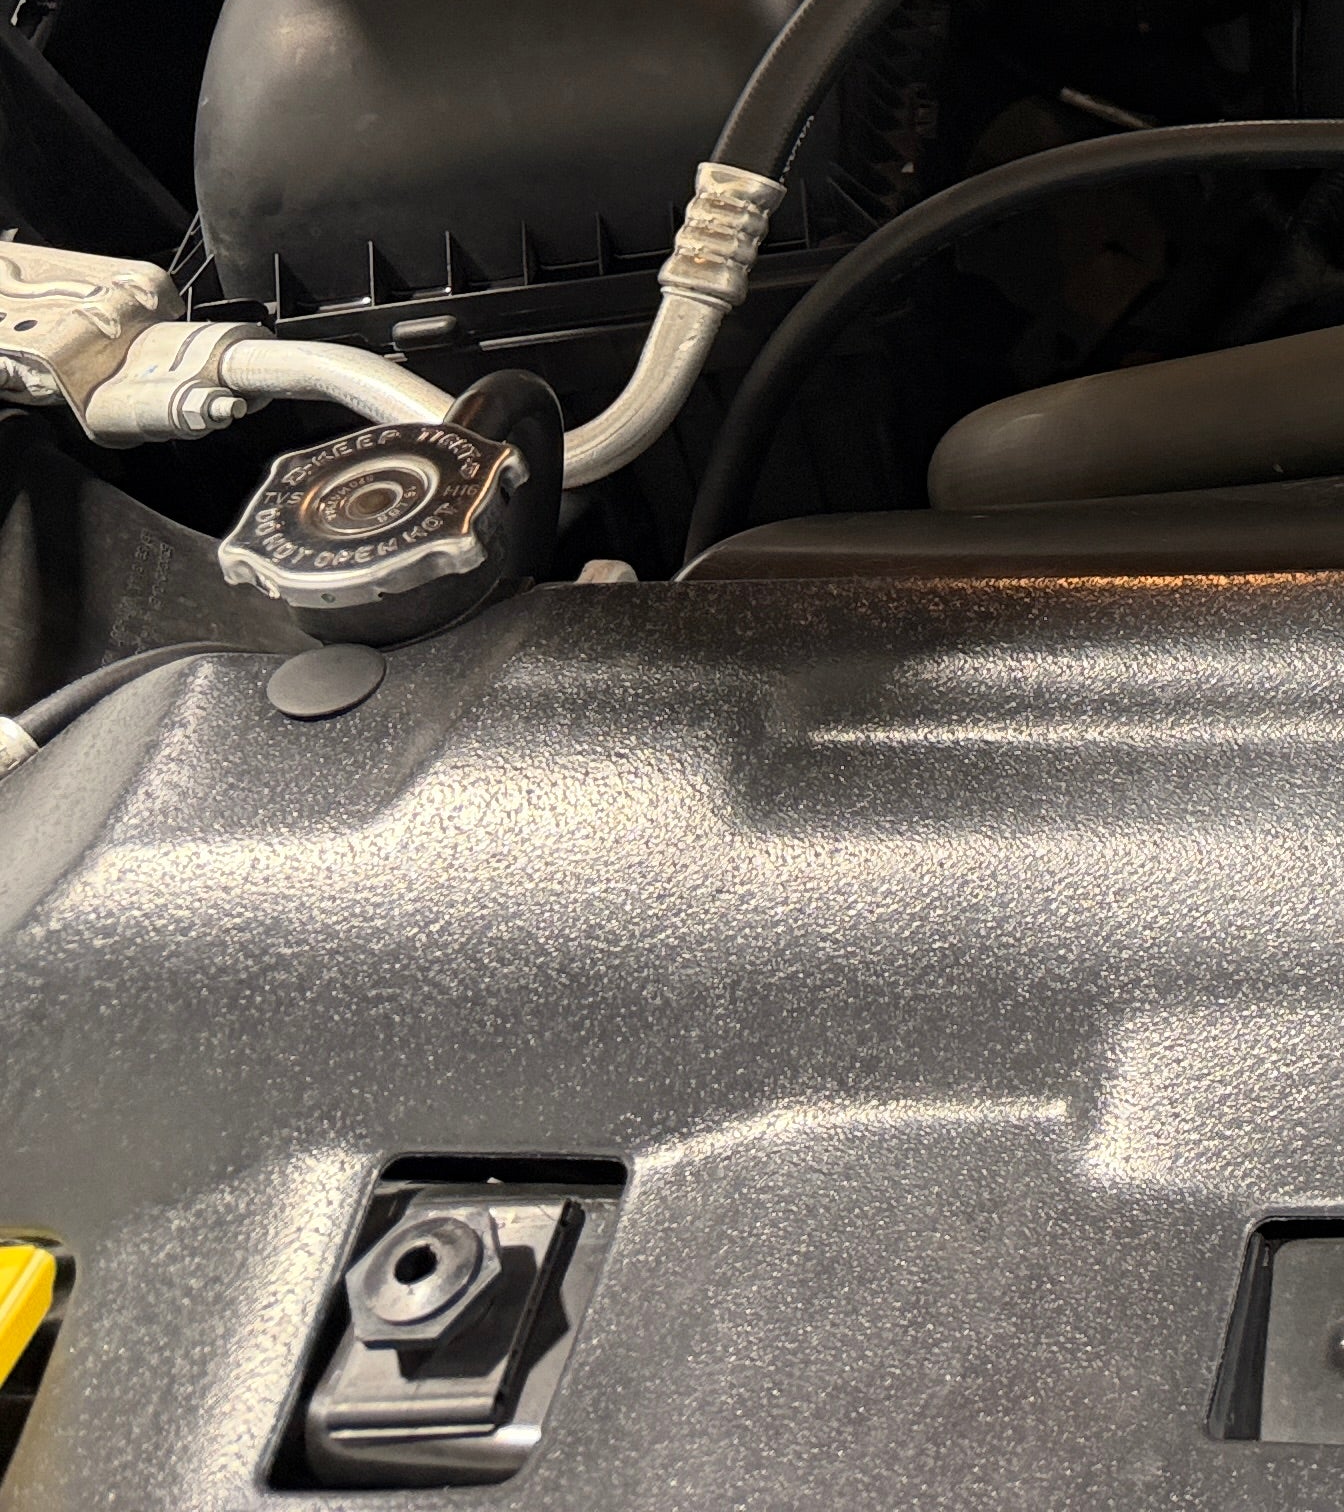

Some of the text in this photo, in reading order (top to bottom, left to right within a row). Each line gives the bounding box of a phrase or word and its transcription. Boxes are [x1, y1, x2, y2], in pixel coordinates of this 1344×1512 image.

[311, 429, 400, 467] KEEP
[264, 491, 305, 505] TVS
[262, 533, 314, 565] NOT
[314, 538, 399, 568] OPEN
[402, 502, 458, 543] HOT
